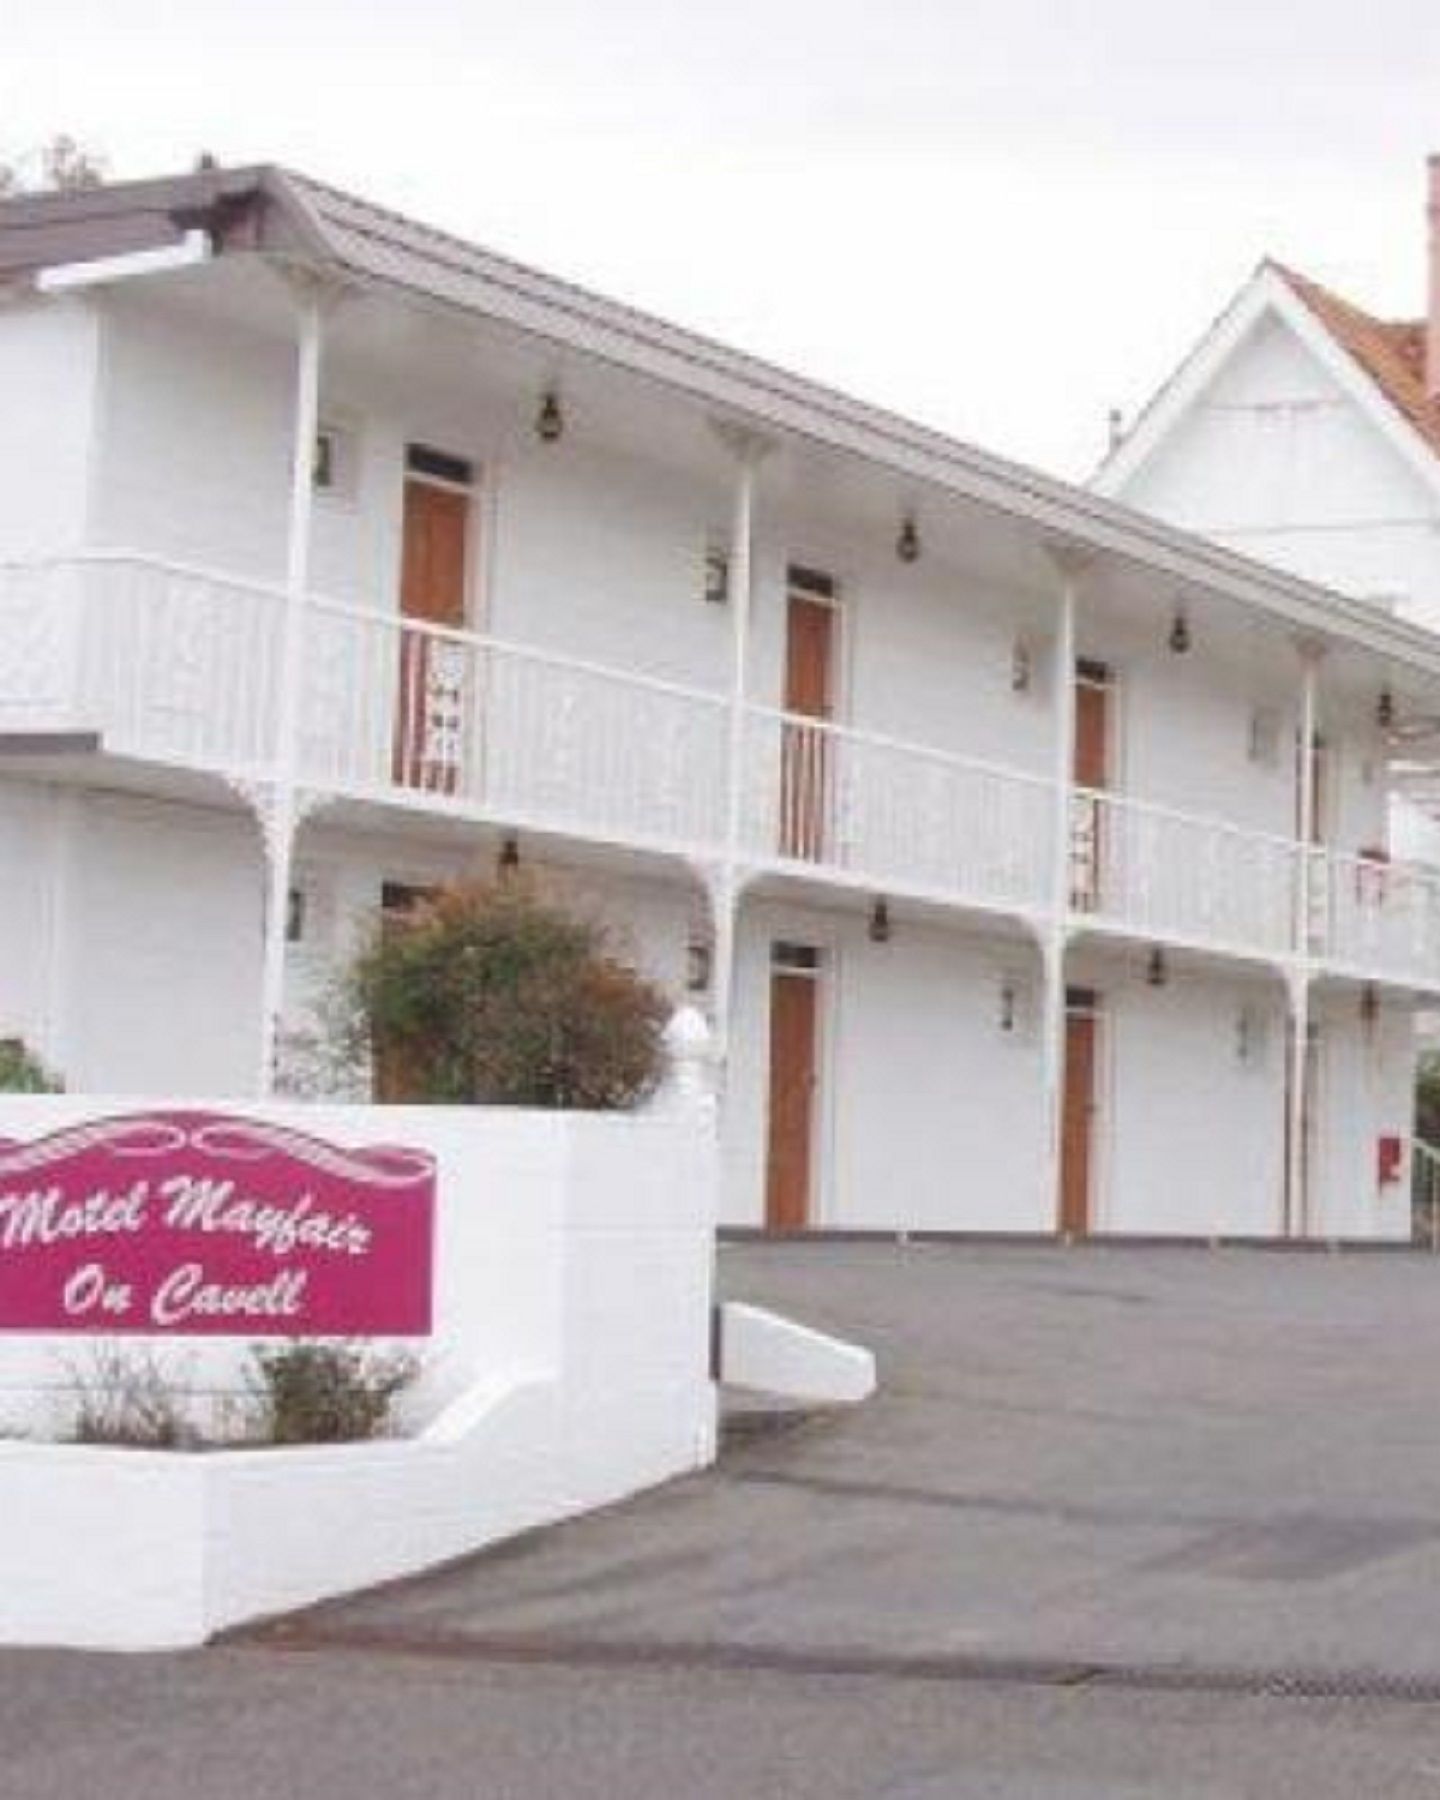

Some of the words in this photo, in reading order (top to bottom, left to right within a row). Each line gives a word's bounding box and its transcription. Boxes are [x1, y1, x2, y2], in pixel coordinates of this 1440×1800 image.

[0, 1179, 149, 1248] Motel
[157, 1174, 373, 1255] Mayfair
[63, 1263, 132, 1315] On
[150, 1263, 309, 1326] Cavell
